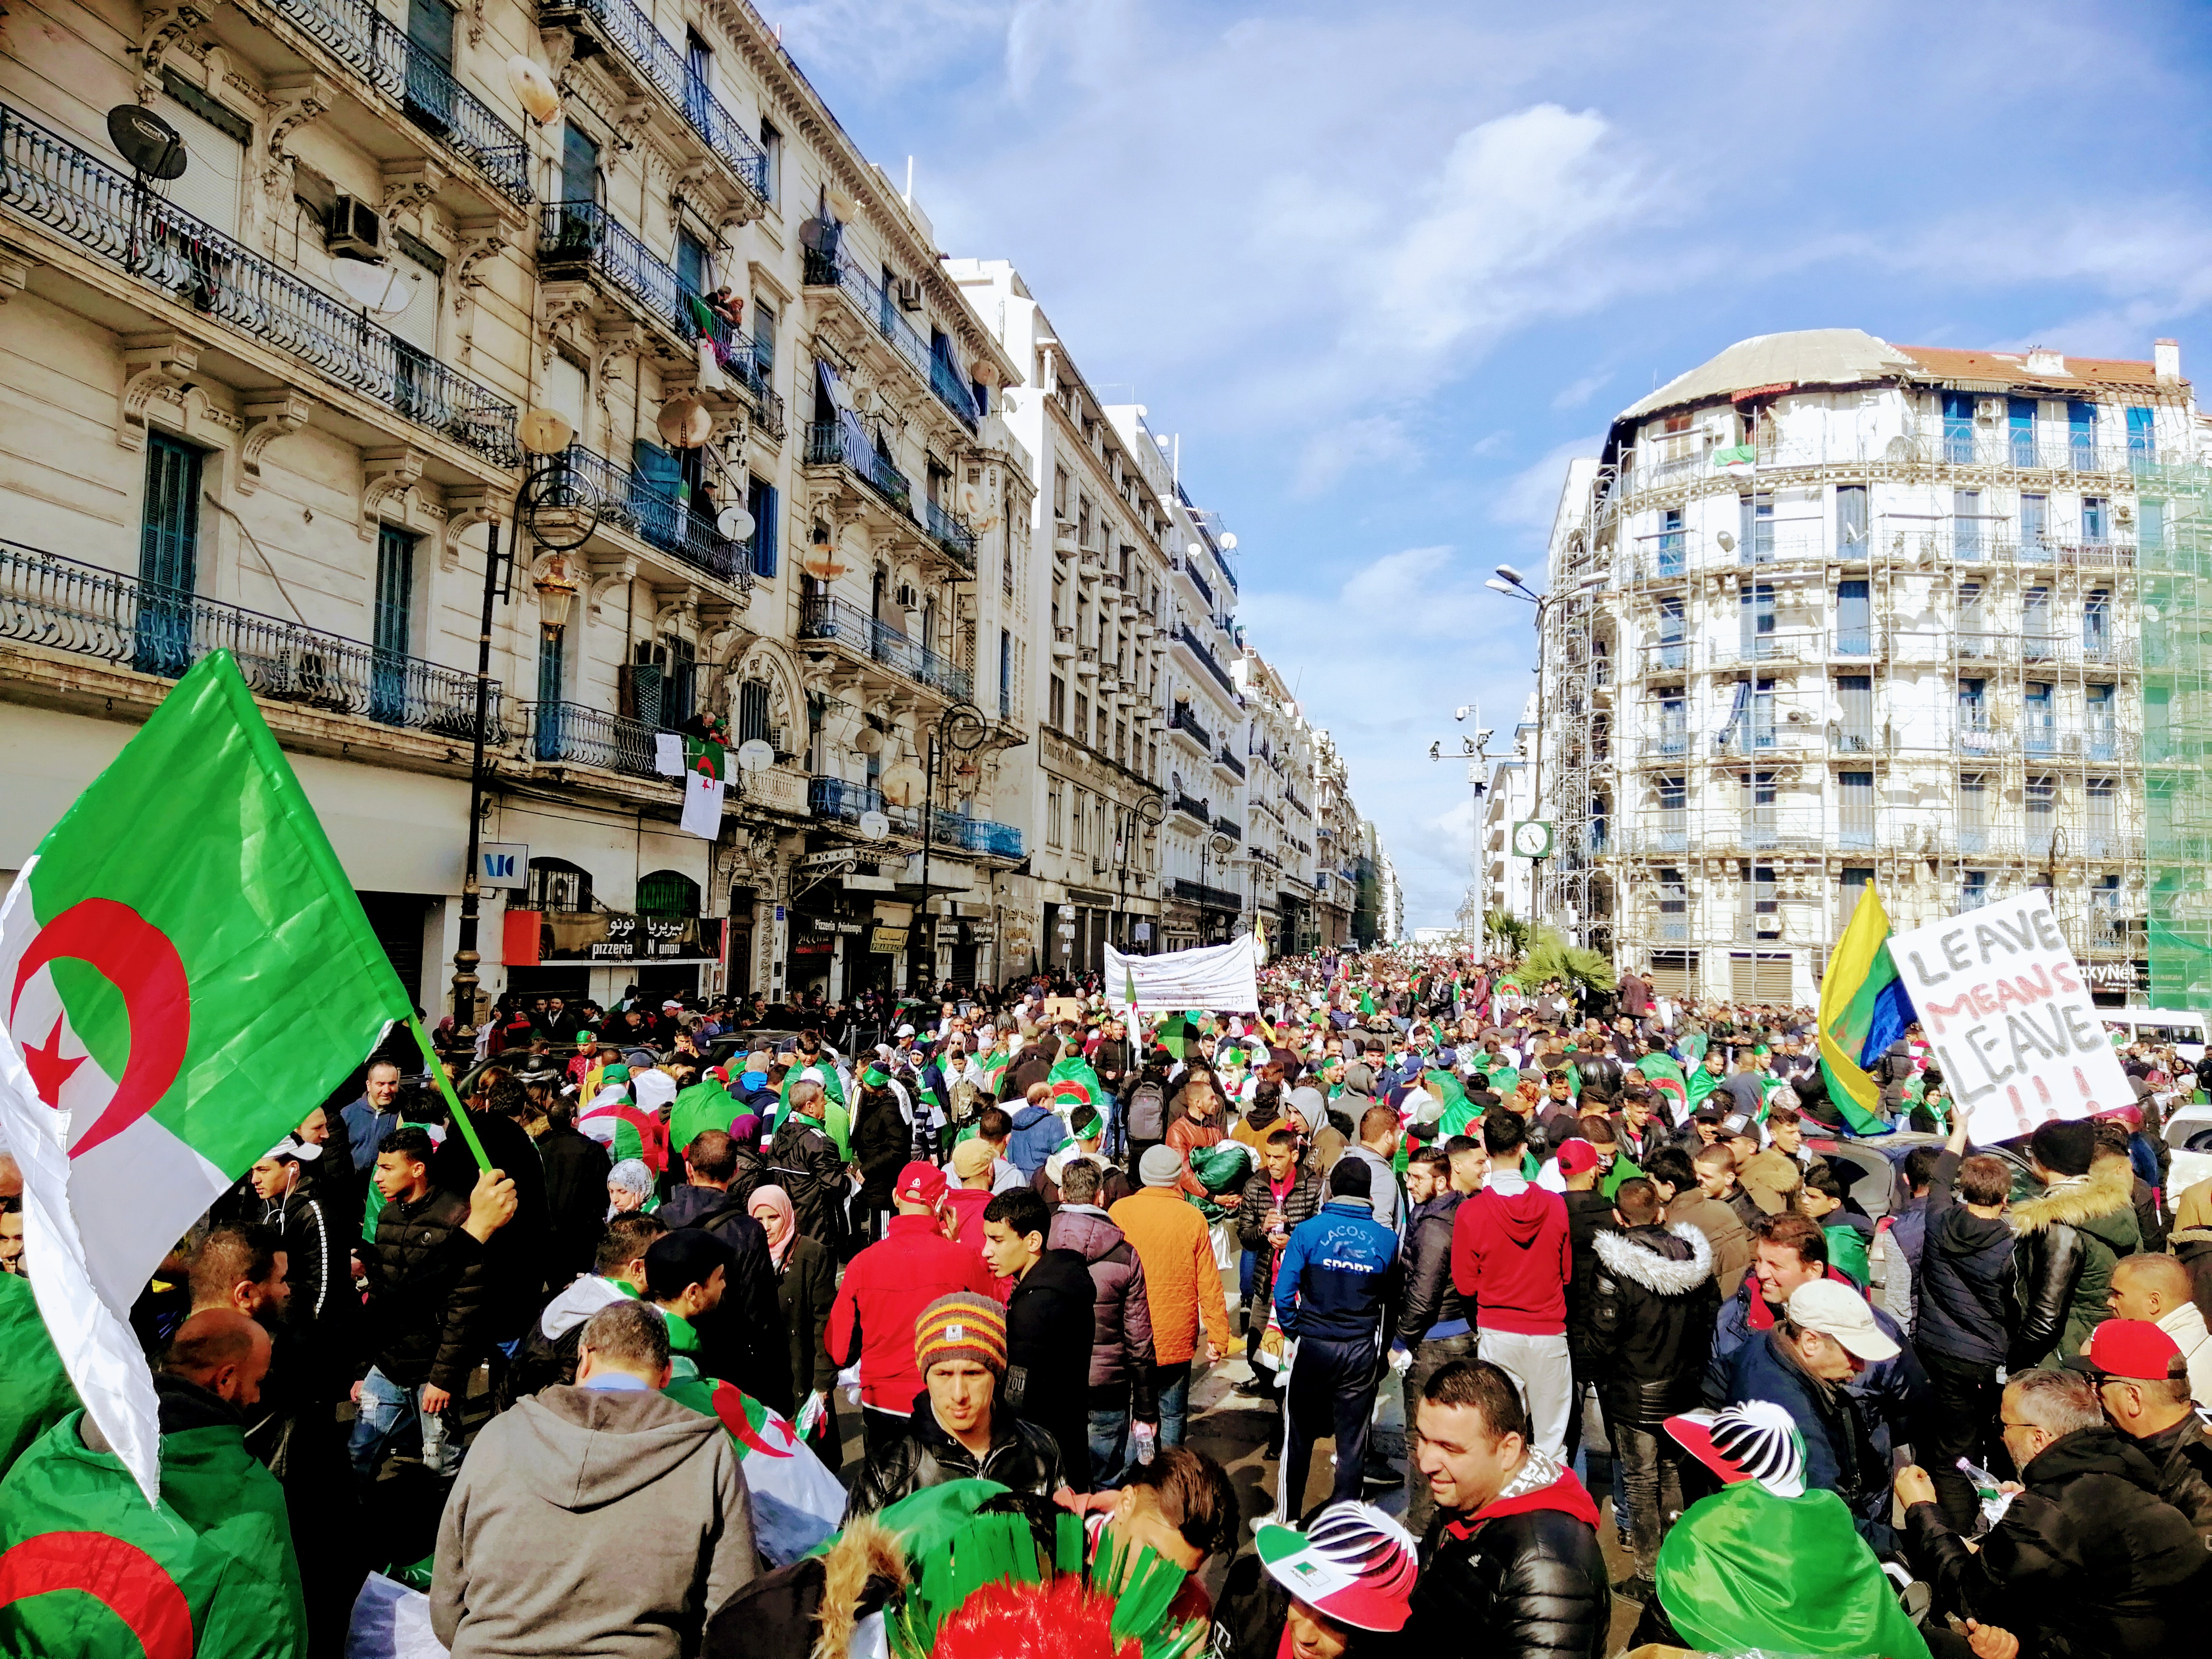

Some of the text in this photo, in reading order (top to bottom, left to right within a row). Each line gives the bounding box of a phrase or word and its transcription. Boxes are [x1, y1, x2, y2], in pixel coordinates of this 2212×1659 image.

[604, 917, 636, 936] نونو
[815, 919, 863, 935] Pizzeria Printemps
[592, 940, 633, 960] pizzeria
[872, 943, 904, 952] PHARMACIE
[1908, 909, 2065, 987] LEAVE
[1925, 962, 2080, 1035] MEANS
[1936, 1002, 2104, 1106] LEAVE
